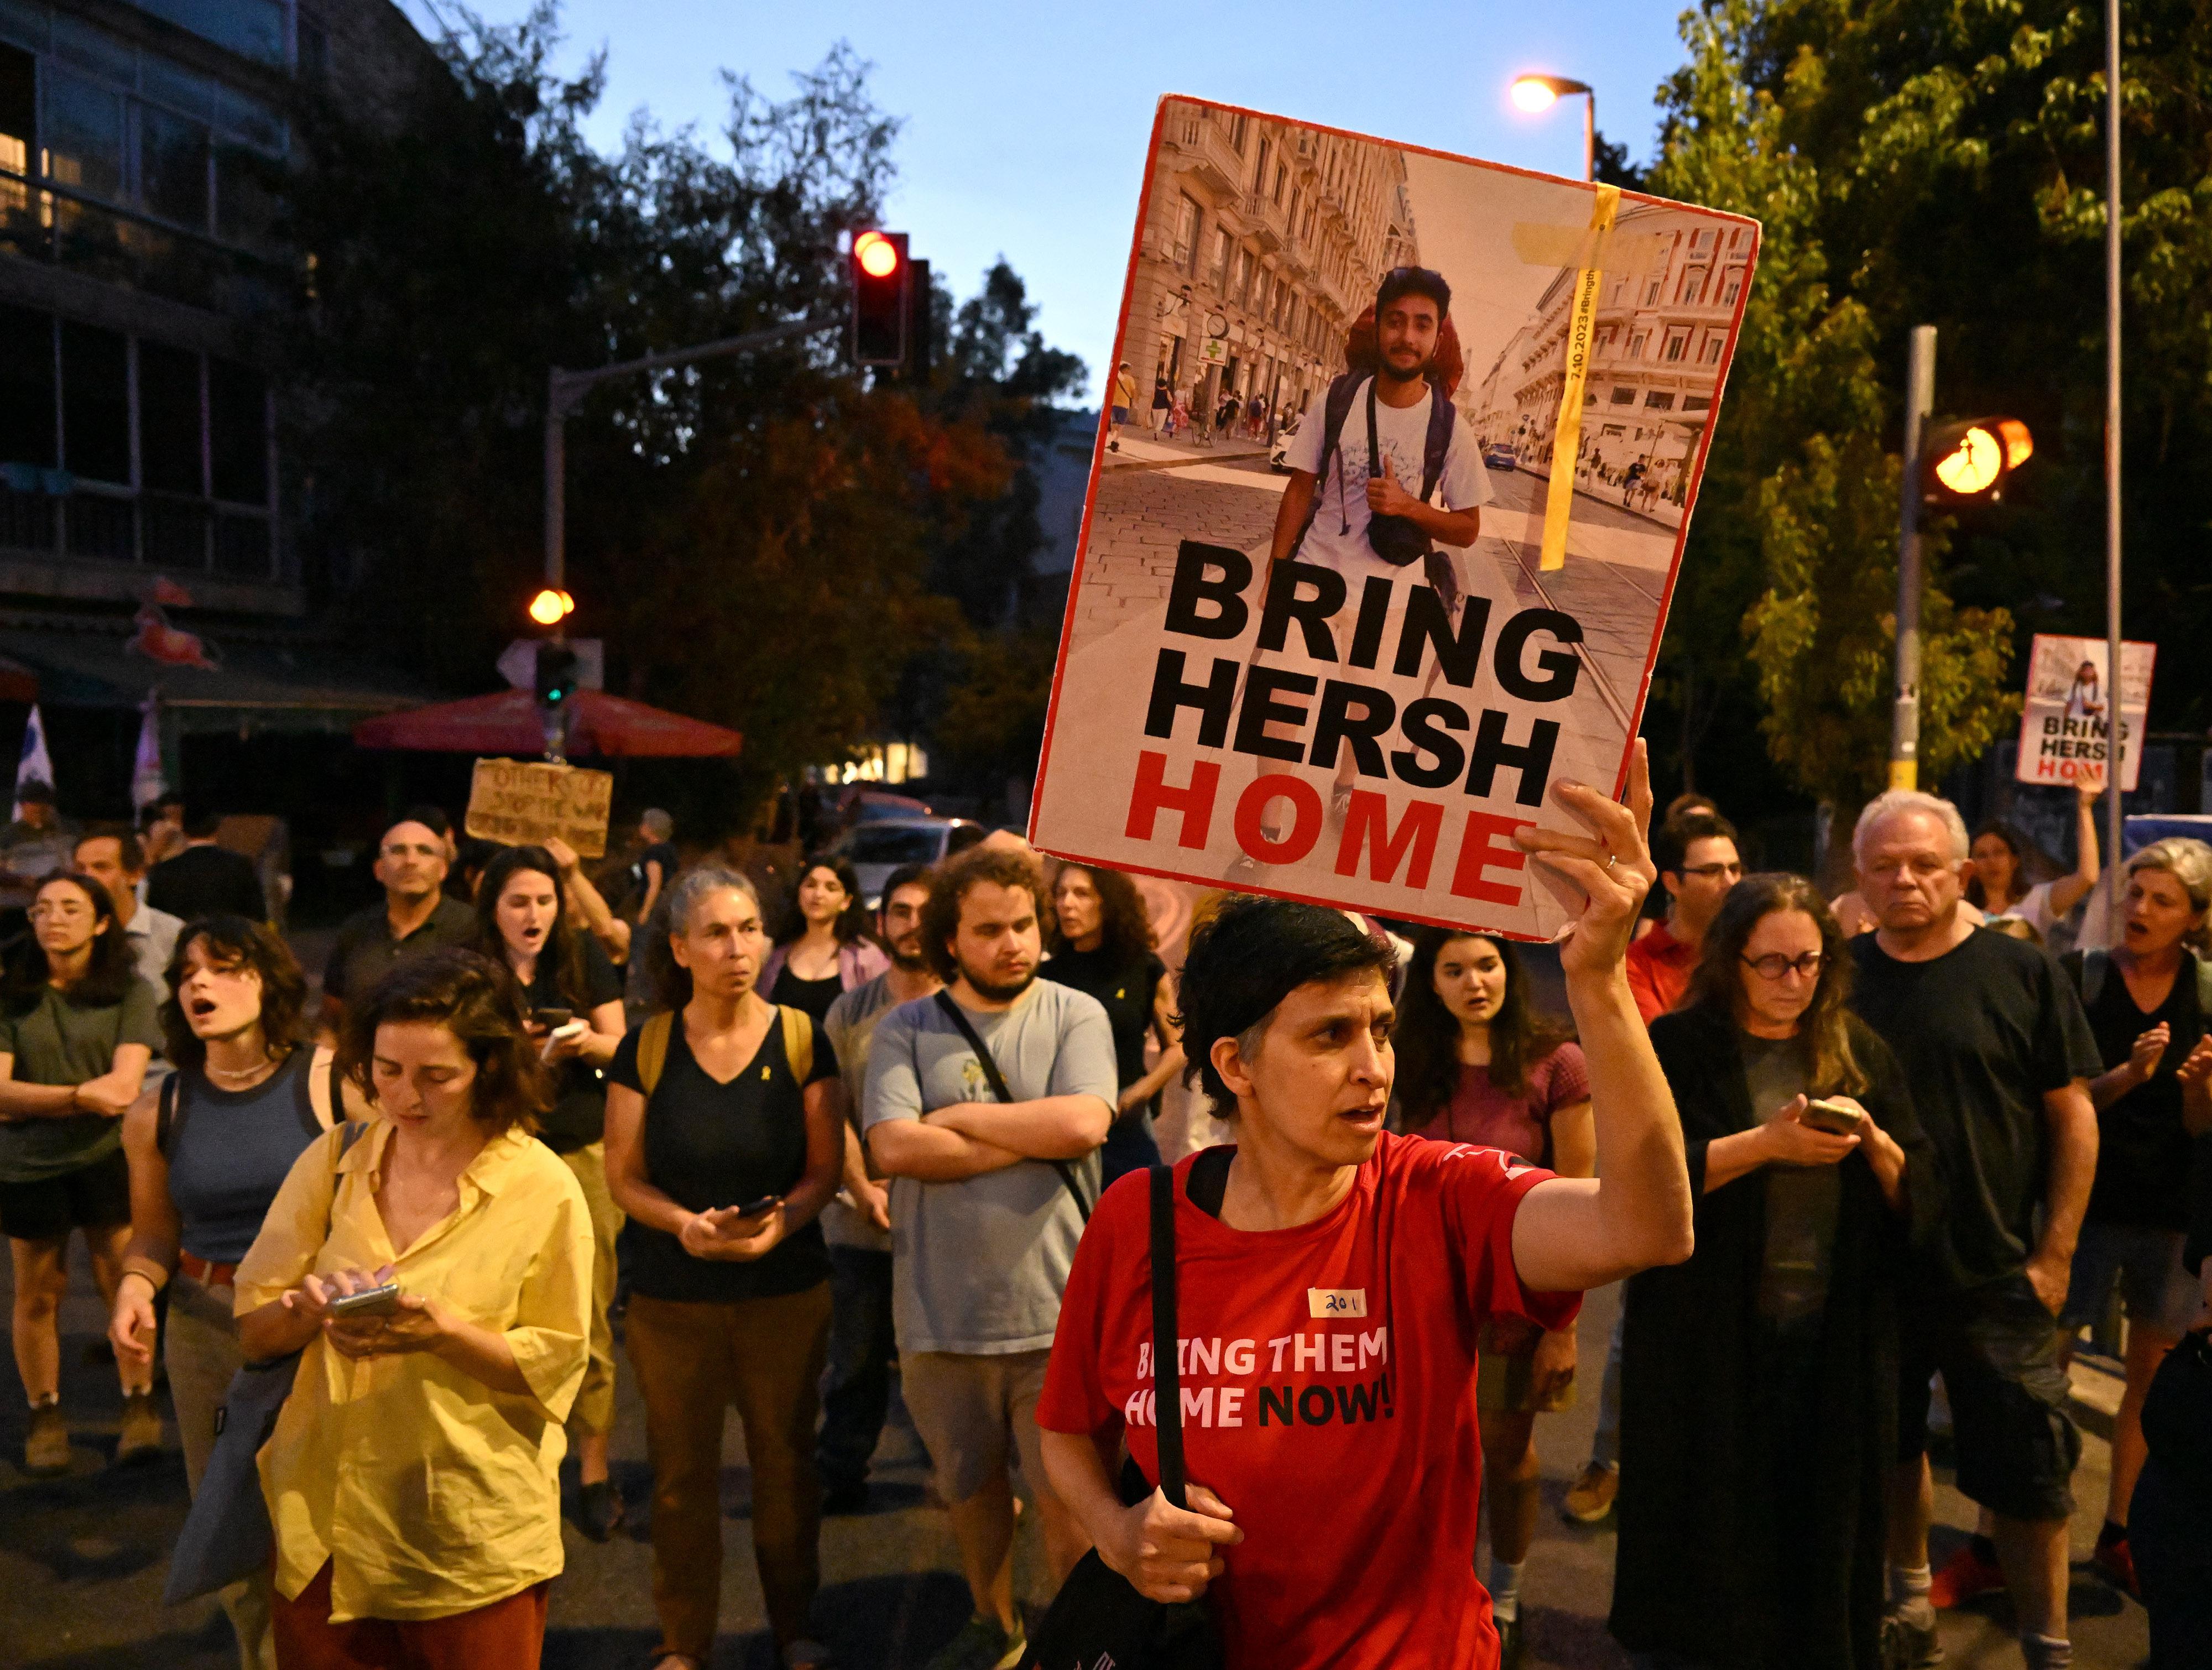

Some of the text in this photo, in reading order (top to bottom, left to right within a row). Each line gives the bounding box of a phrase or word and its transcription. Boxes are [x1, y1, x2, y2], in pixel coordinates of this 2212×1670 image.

[1571, 316, 1589, 379] 7.10.2023
[1165, 539, 1584, 702] BRING
[1144, 648, 1560, 807] HERSH
[2037, 758, 2104, 779] HOM
[1125, 750, 1537, 906] HOME
[1326, 1294, 1356, 1312] 201
[1137, 1327, 1387, 1380] BING THEM
[1259, 1372, 1394, 1427] NOW!
